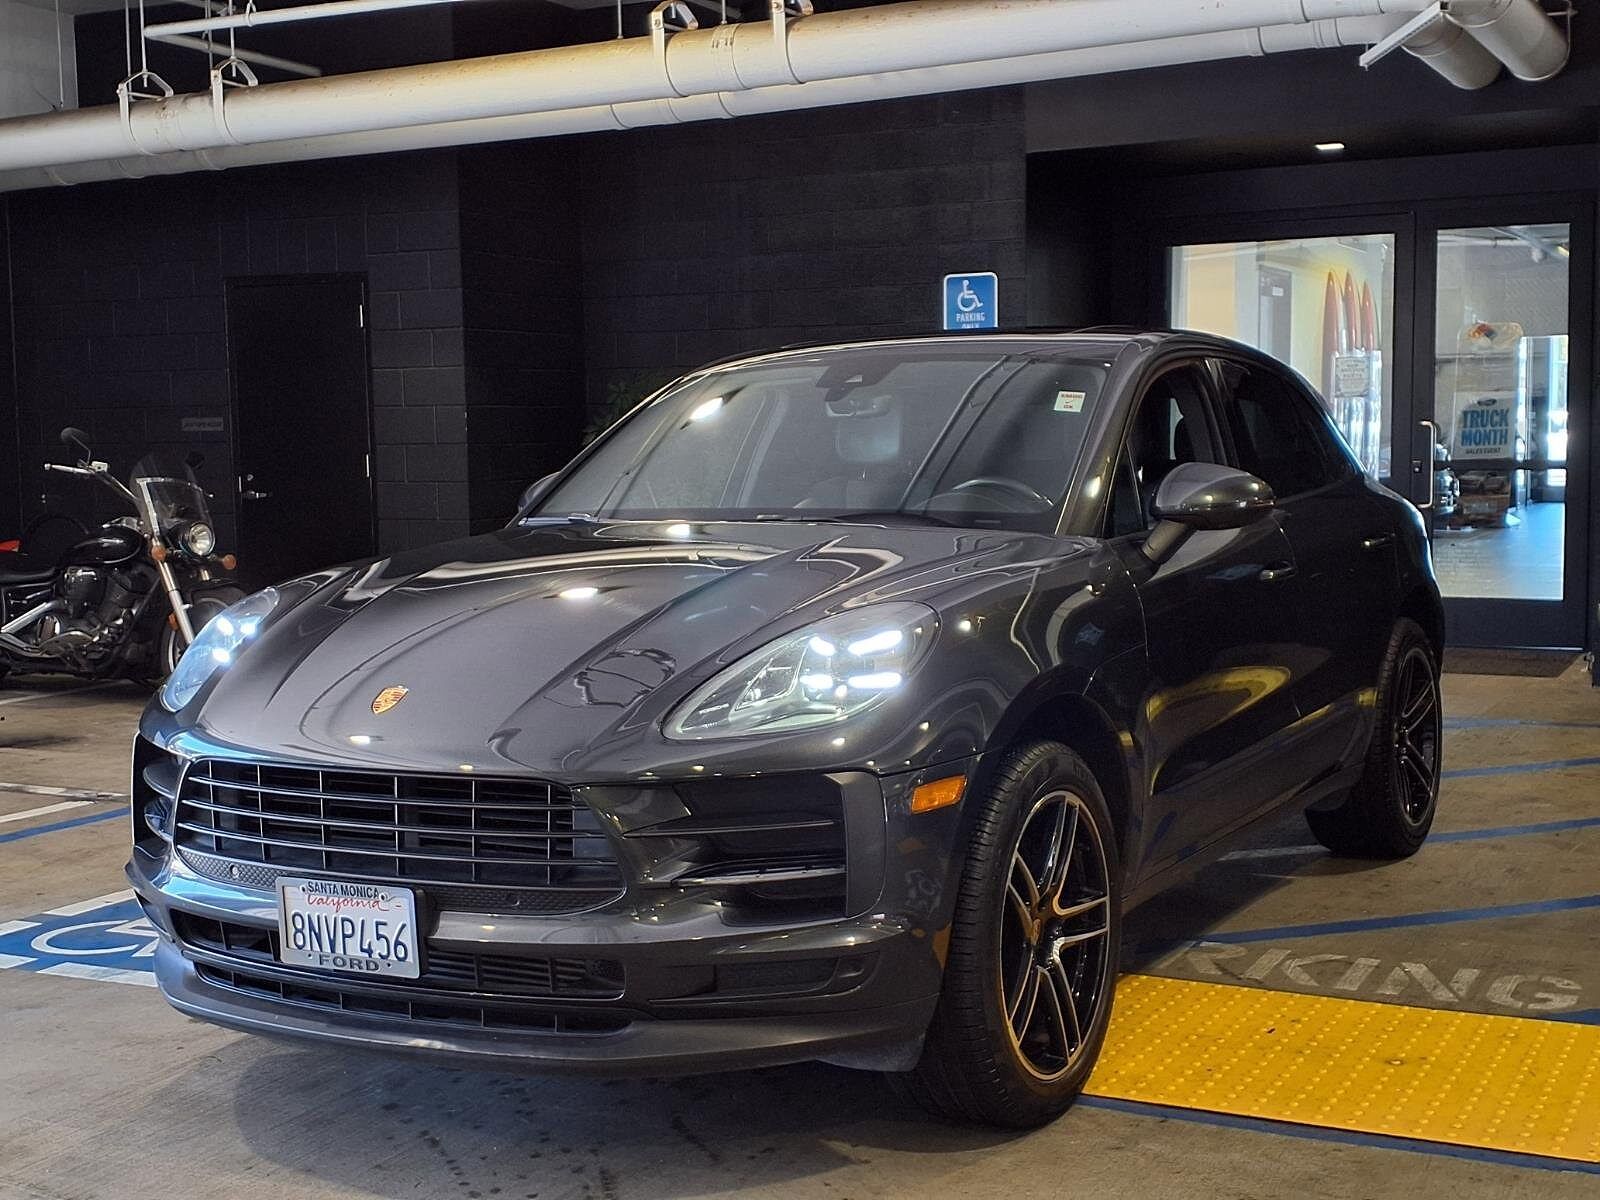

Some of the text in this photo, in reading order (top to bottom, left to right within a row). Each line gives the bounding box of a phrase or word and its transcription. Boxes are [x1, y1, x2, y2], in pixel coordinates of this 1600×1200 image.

[956, 312, 986, 323] PARKING
[1462, 408, 1509, 428] TRUCK
[1461, 428, 1508, 446] MONTH
[307, 881, 380, 899] SANTA MONICA
[307, 895, 390, 913] California
[291, 911, 408, 962] 8NVP456
[319, 954, 380, 971] FORD
